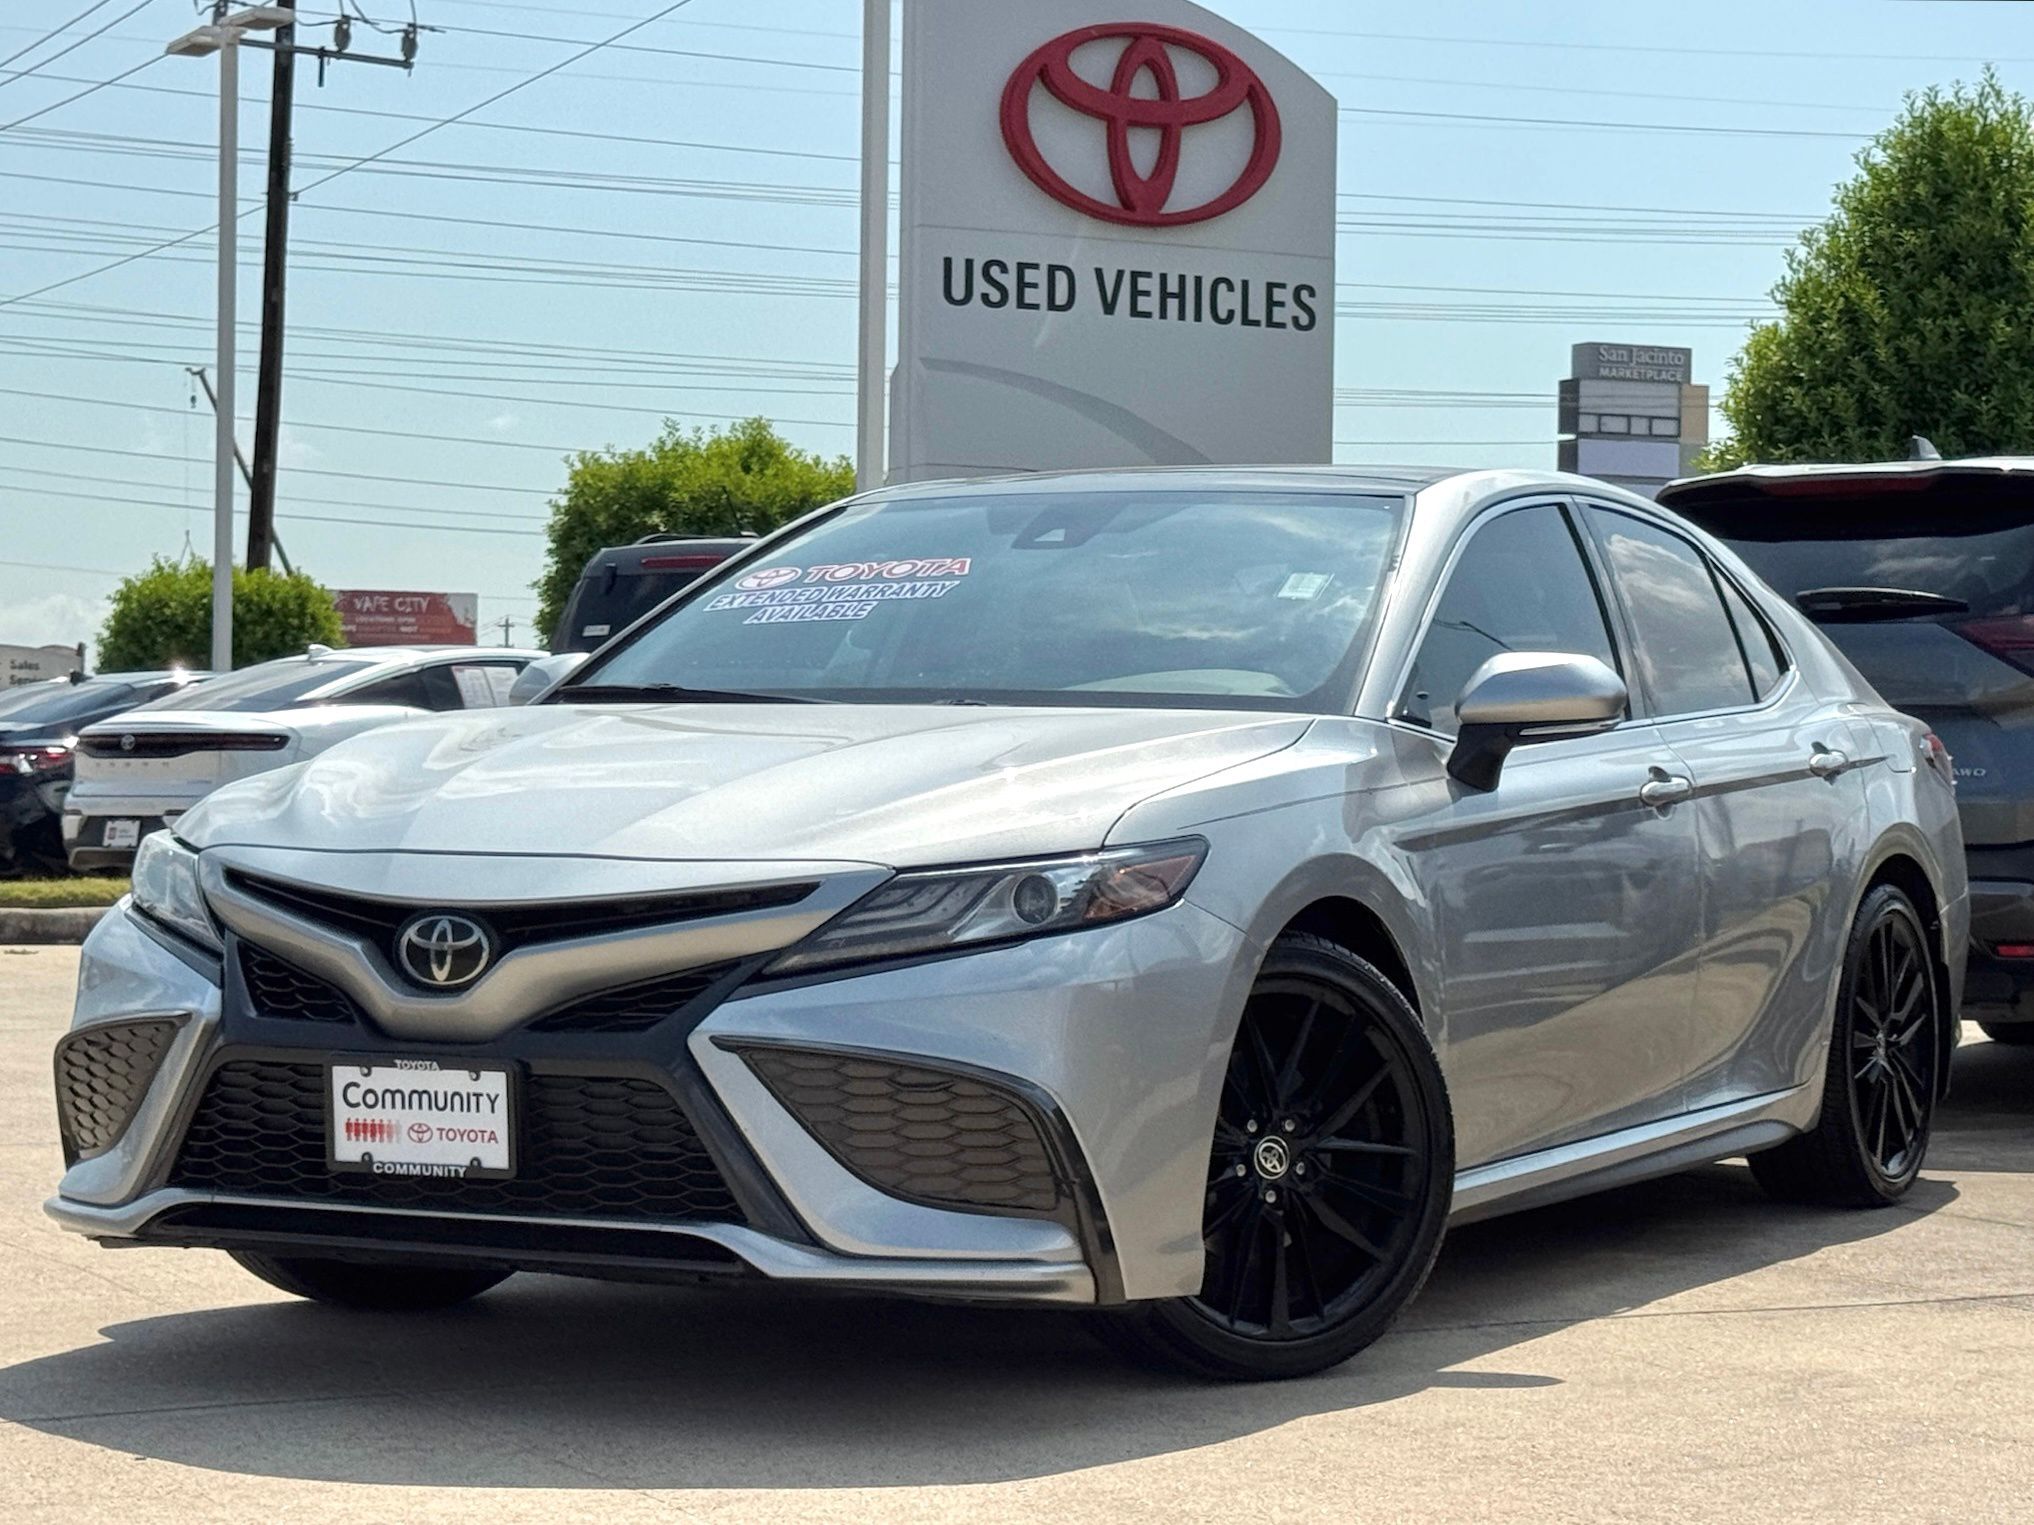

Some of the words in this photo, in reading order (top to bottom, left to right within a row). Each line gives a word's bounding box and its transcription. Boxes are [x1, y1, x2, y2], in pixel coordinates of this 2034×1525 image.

[942, 256, 1076, 312] USED
[1094, 267, 1317, 332] VEHICLES
[1599, 345, 1628, 361] San
[1632, 347, 1685, 366] Jacinto
[1600, 367, 1683, 382] MARKETPLACE
[804, 558, 971, 583] TOYOTA
[353, 595, 390, 612] VAPE
[394, 596, 431, 613] CITY
[705, 587, 828, 611] EXTENDED
[828, 581, 959, 601] WARRANTY
[744, 601, 878, 624] AVAILABLE
[9, 659, 40, 671] Sales
[393, 1059, 440, 1072] TOYOTA
[436, 1127, 499, 1144] TOYOTA
[372, 1162, 467, 1178] COMMUNITY
